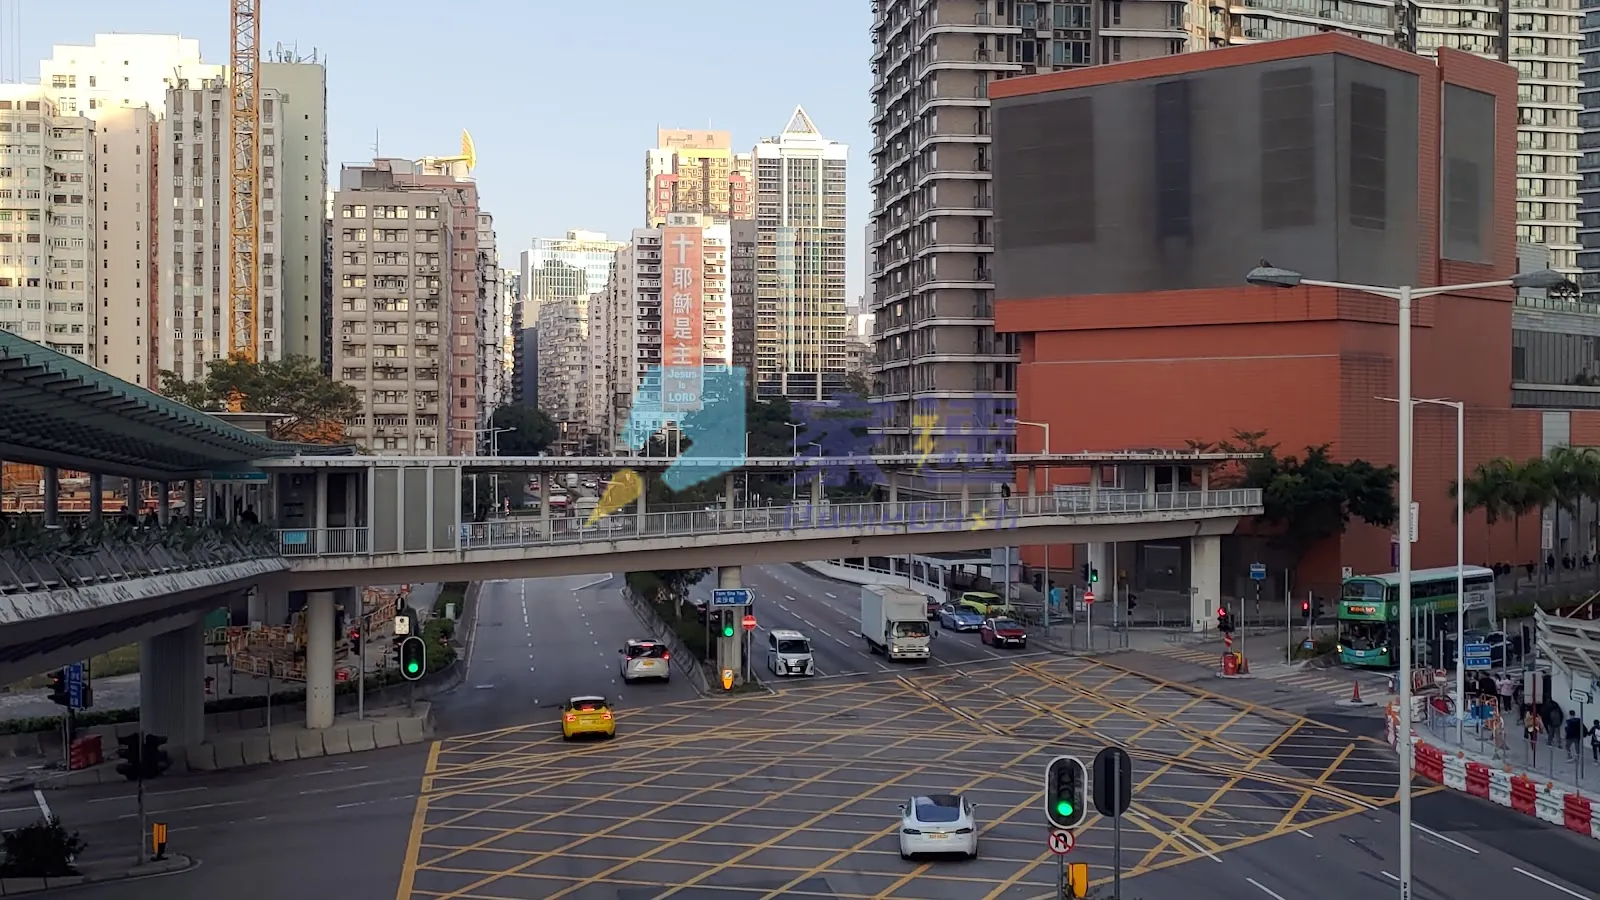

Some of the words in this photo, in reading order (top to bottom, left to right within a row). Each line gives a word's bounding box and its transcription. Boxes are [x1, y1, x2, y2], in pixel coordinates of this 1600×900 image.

[672, 267, 694, 365] 耶穌是主
[667, 368, 697, 379] Jesus
[668, 391, 697, 402] LORD
